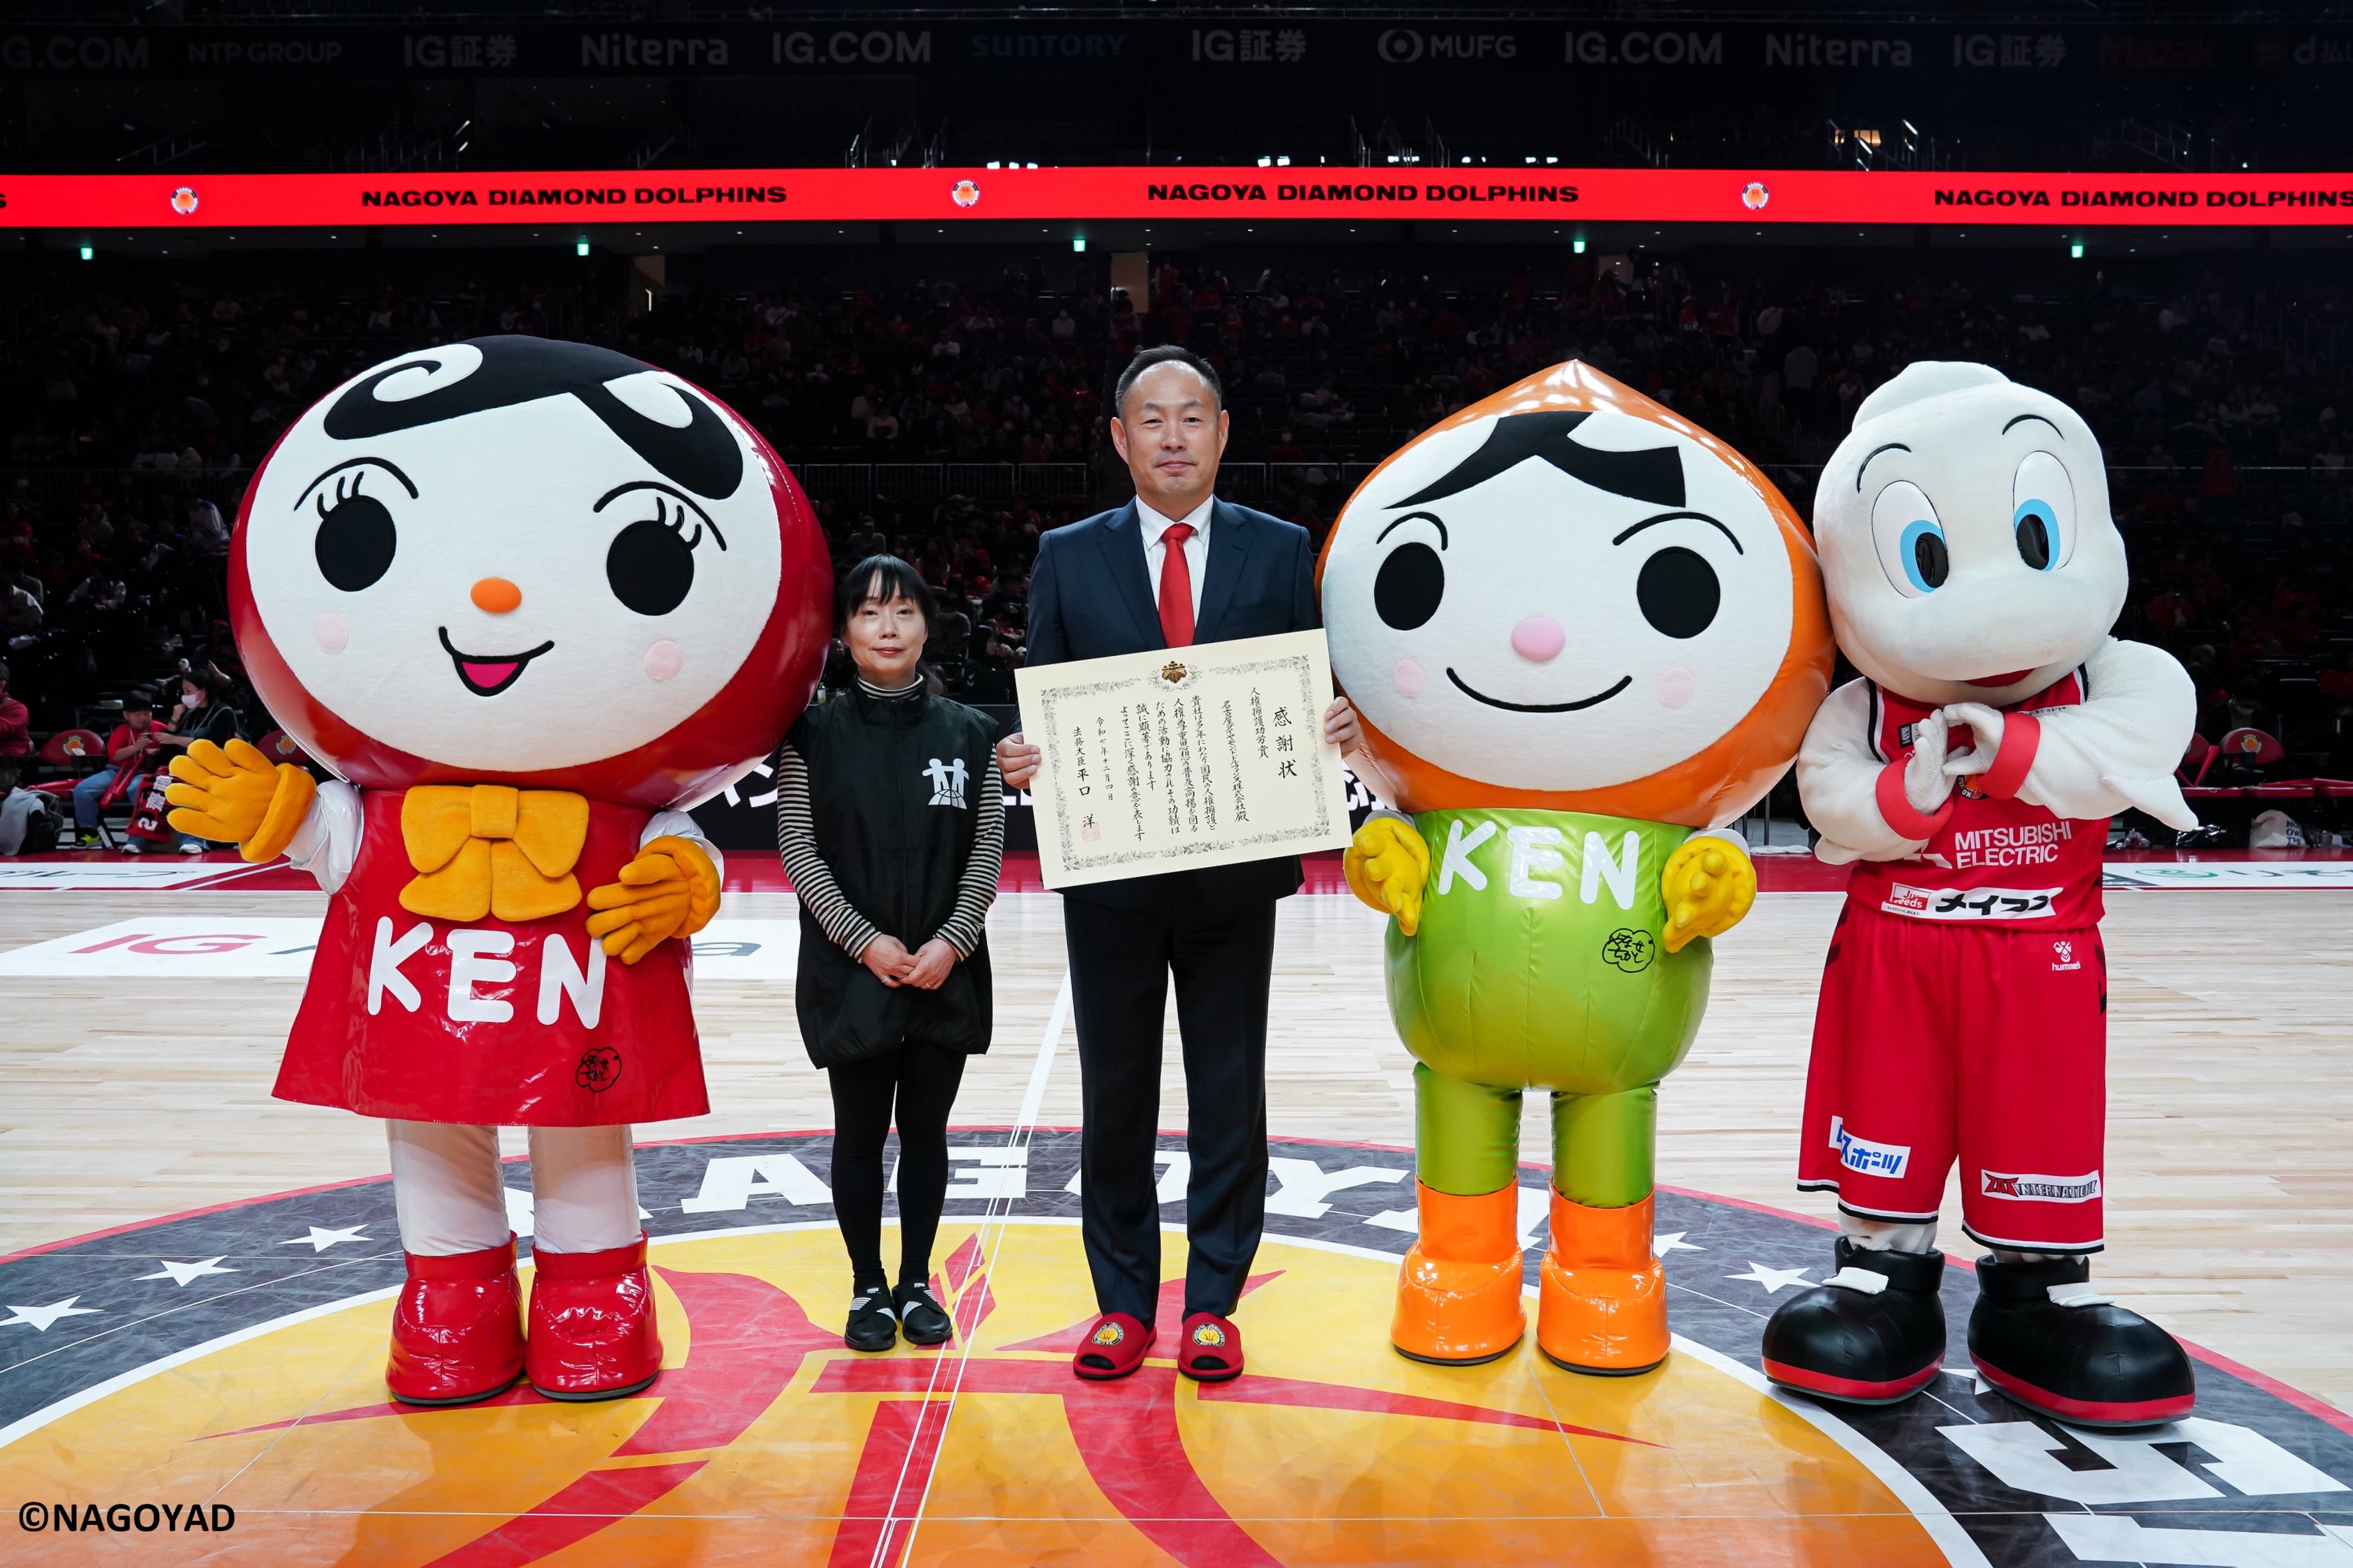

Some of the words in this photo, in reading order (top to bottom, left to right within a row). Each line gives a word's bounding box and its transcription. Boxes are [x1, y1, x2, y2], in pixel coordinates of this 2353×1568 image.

[188, 42, 242, 63] NTP
[247, 41, 342, 63] GROUP
[581, 33, 728, 66] Niterra
[773, 31, 931, 63] IG.COM
[1430, 35, 1516, 58] MUFG
[1565, 31, 1723, 64] IG.COM
[1765, 33, 1913, 68] Niterra
[362, 190, 478, 206] NAGOYA
[489, 189, 627, 205] DIAMOND
[634, 186, 786, 204] DOLPHINS
[1148, 184, 1266, 201] NAGOYA
[1278, 185, 1418, 201] DIAMOND
[1426, 185, 1579, 202] DOLPHINS
[1935, 190, 2050, 206] NAGOYA
[2061, 191, 2199, 207] DIAMOND
[2206, 190, 2353, 207] DOLPHINS
[1250, 687, 1269, 759] 人権擁護功労賞
[1096, 717, 1114, 800] 令和七年十二月四日
[1273, 706, 1297, 778] 感謝状
[1121, 706, 1145, 842] よってここに深く感謝の意を表します
[1156, 701, 1180, 834] ための活動に協力されその功績は
[1173, 698, 1198, 832] 人権尊重思想の普及高揚を図る
[1191, 696, 1216, 830] 貴社は多年にわたり国民の人権擁護と
[1955, 821, 2072, 851] MITSUBISHI
[1438, 819, 1640, 910] KEN
[1956, 843, 2059, 869] ELECTRIC
[68, 934, 268, 955] IG
[366, 915, 607, 1030] KEN
